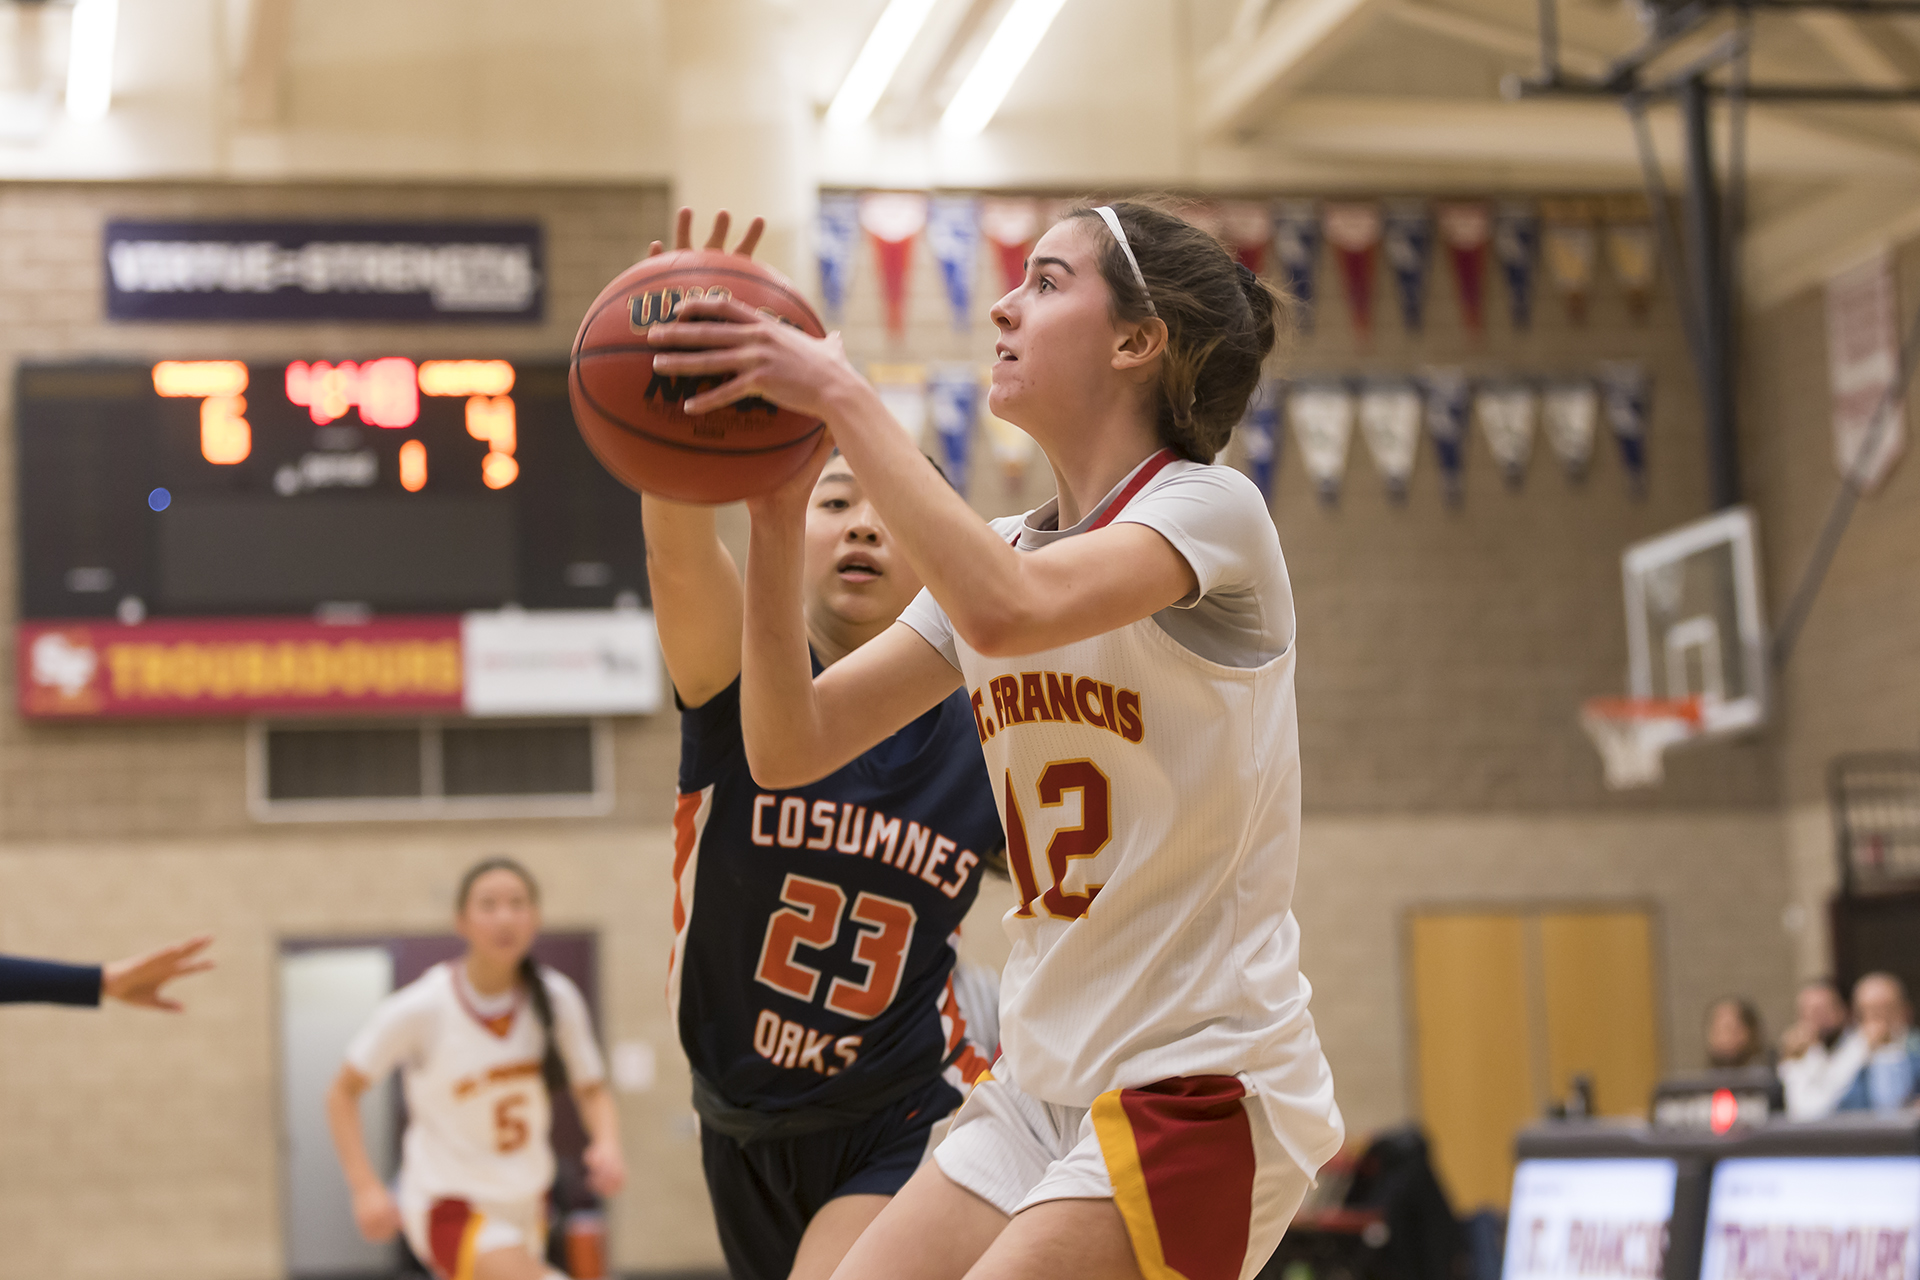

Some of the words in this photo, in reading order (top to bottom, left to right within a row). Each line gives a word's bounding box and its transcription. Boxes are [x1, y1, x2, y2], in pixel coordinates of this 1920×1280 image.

[108, 642, 461, 697] TROUBADOURS
[989, 671, 1145, 745] FRANCIS
[751, 794, 979, 899] COSUMNES
[1005, 757, 1113, 922] 12
[753, 872, 919, 1021] 23
[753, 1008, 863, 1077] OAKS
[492, 1096, 530, 1154] 5
